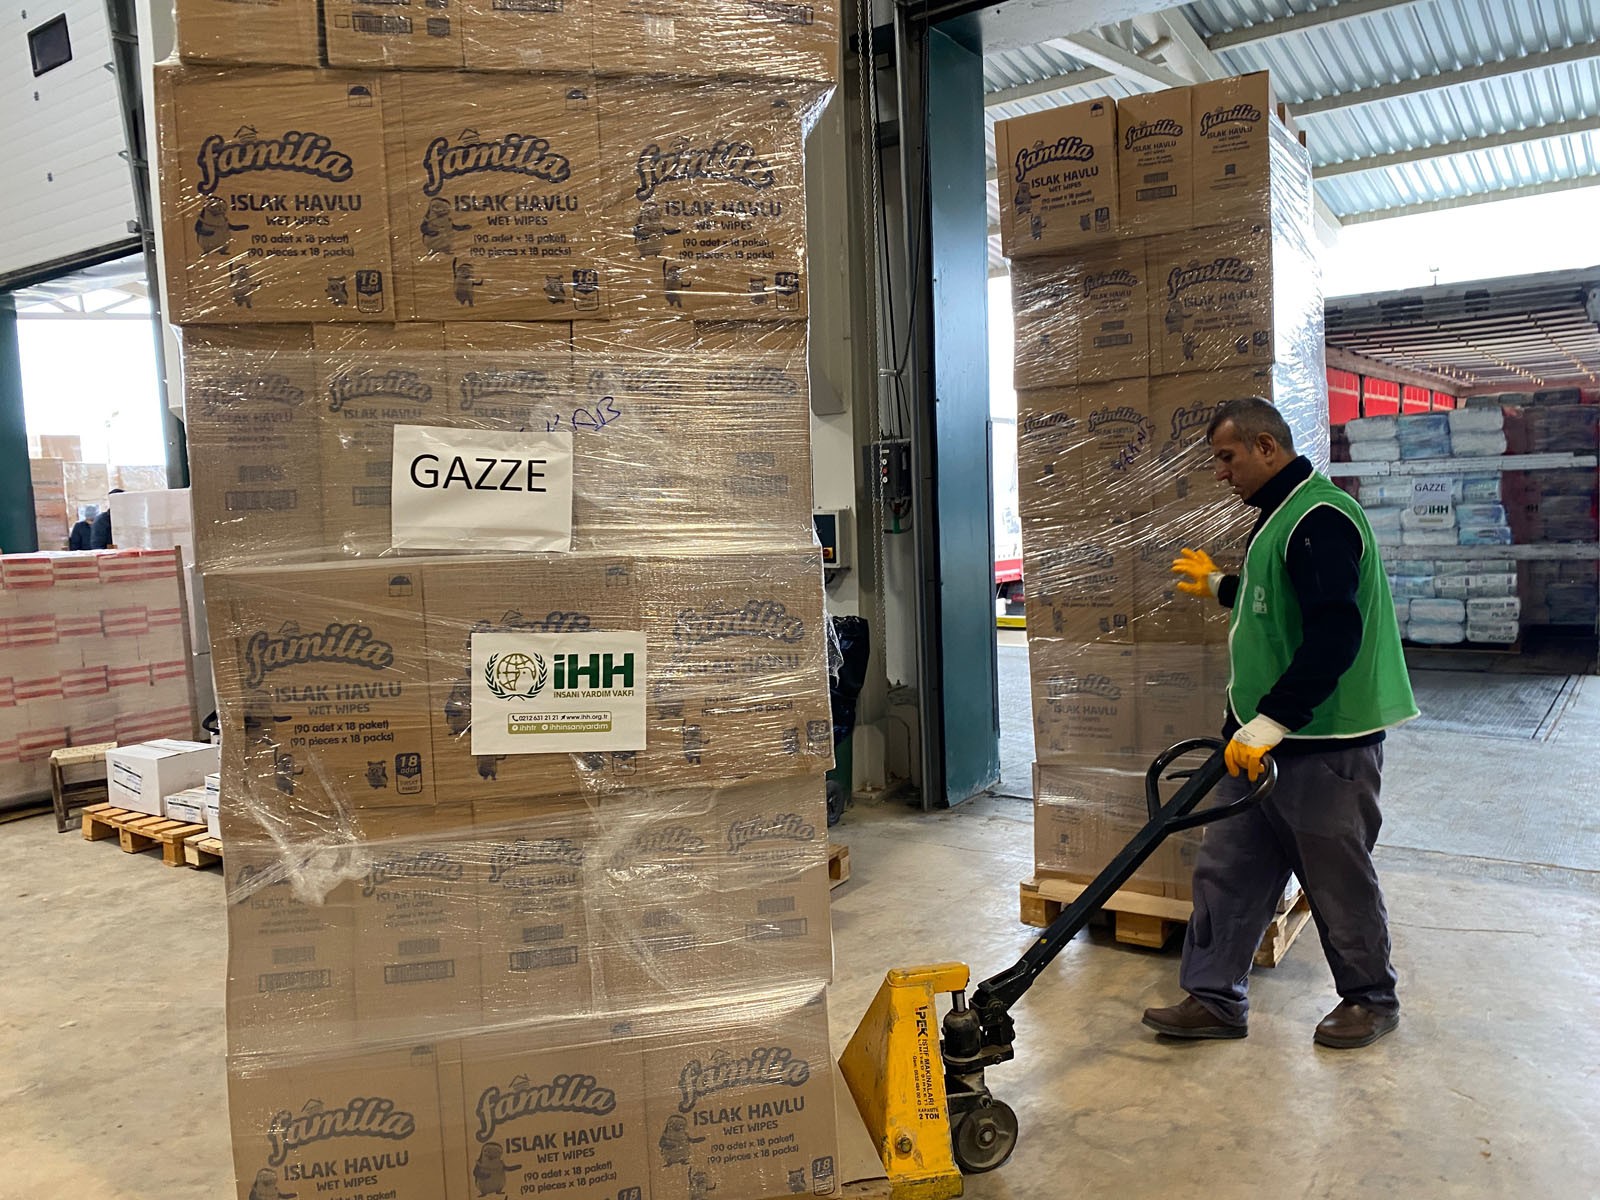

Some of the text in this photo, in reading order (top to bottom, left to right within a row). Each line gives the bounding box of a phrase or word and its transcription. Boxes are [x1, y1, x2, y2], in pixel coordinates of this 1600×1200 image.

[1200, 104, 1262, 136] familia
[1124, 119, 1183, 150] familia
[1154, 140, 1176, 150] HAVLU
[197, 130, 354, 195] familia
[422, 133, 572, 197] familia
[1015, 136, 1094, 183] familia
[1032, 166, 1098, 188] ISLAK HAVLU
[231, 195, 362, 212] ISLAK HAVLU
[454, 195, 578, 212] ISLAK HAVLU
[487, 216, 548, 226] WET WIPES
[721, 220, 752, 230] WIPES
[270, 234, 294, 244] adet
[682, 239, 698, 248] (90
[700, 239, 721, 247] adet
[266, 247, 298, 258] pieces
[488, 247, 518, 258] pieces
[360, 272, 380, 285] 18
[577, 272, 594, 284] 18
[1166, 257, 1254, 301] familia
[1088, 406, 1142, 432] familia
[410, 454, 548, 492] GAZZE
[1414, 482, 1446, 492] GAZZE
[245, 622, 394, 690] familia
[274, 680, 402, 702] ISLAK HAVLU
[581, 690, 611, 698] YARDIM
[308, 703, 370, 716] WET WIPES
[294, 723, 310, 736] (90
[312, 722, 334, 732] adet
[346, 722, 356, 730] 18
[359, 720, 390, 732] paket)
[290, 736, 306, 747] (90
[308, 735, 340, 746] pieces
[350, 734, 360, 744] 18
[362, 733, 394, 745] packs)
[400, 756, 418, 767] 18
[678, 1046, 810, 1114] familia
[475, 1074, 617, 1144] familia
[693, 1096, 805, 1126] ISLAK HAVLU
[266, 1096, 416, 1168] familia
[723, 1120, 778, 1136] WET WIPES
[506, 1122, 624, 1154] ISLAK HAVLU
[710, 1143, 725, 1154] (90
[726, 1140, 748, 1151] adet
[768, 1133, 794, 1146] paket)
[537, 1147, 596, 1164] WET WIPES
[760, 1150, 770, 1158] 18
[772, 1144, 798, 1157] packs)
[284, 1150, 409, 1181] ISLAK HAVLU
[524, 1170, 539, 1182] (90
[541, 1168, 562, 1180] adet
[572, 1166, 582, 1175] 18
[584, 1160, 612, 1176] paket)
[814, 1158, 831, 1170] 18
[316, 1175, 378, 1192] WET WIPES
[520, 1184, 536, 1196] (90
[538, 1180, 567, 1194] pieces
[576, 1178, 586, 1186] 18
[588, 1172, 617, 1186] packs)
